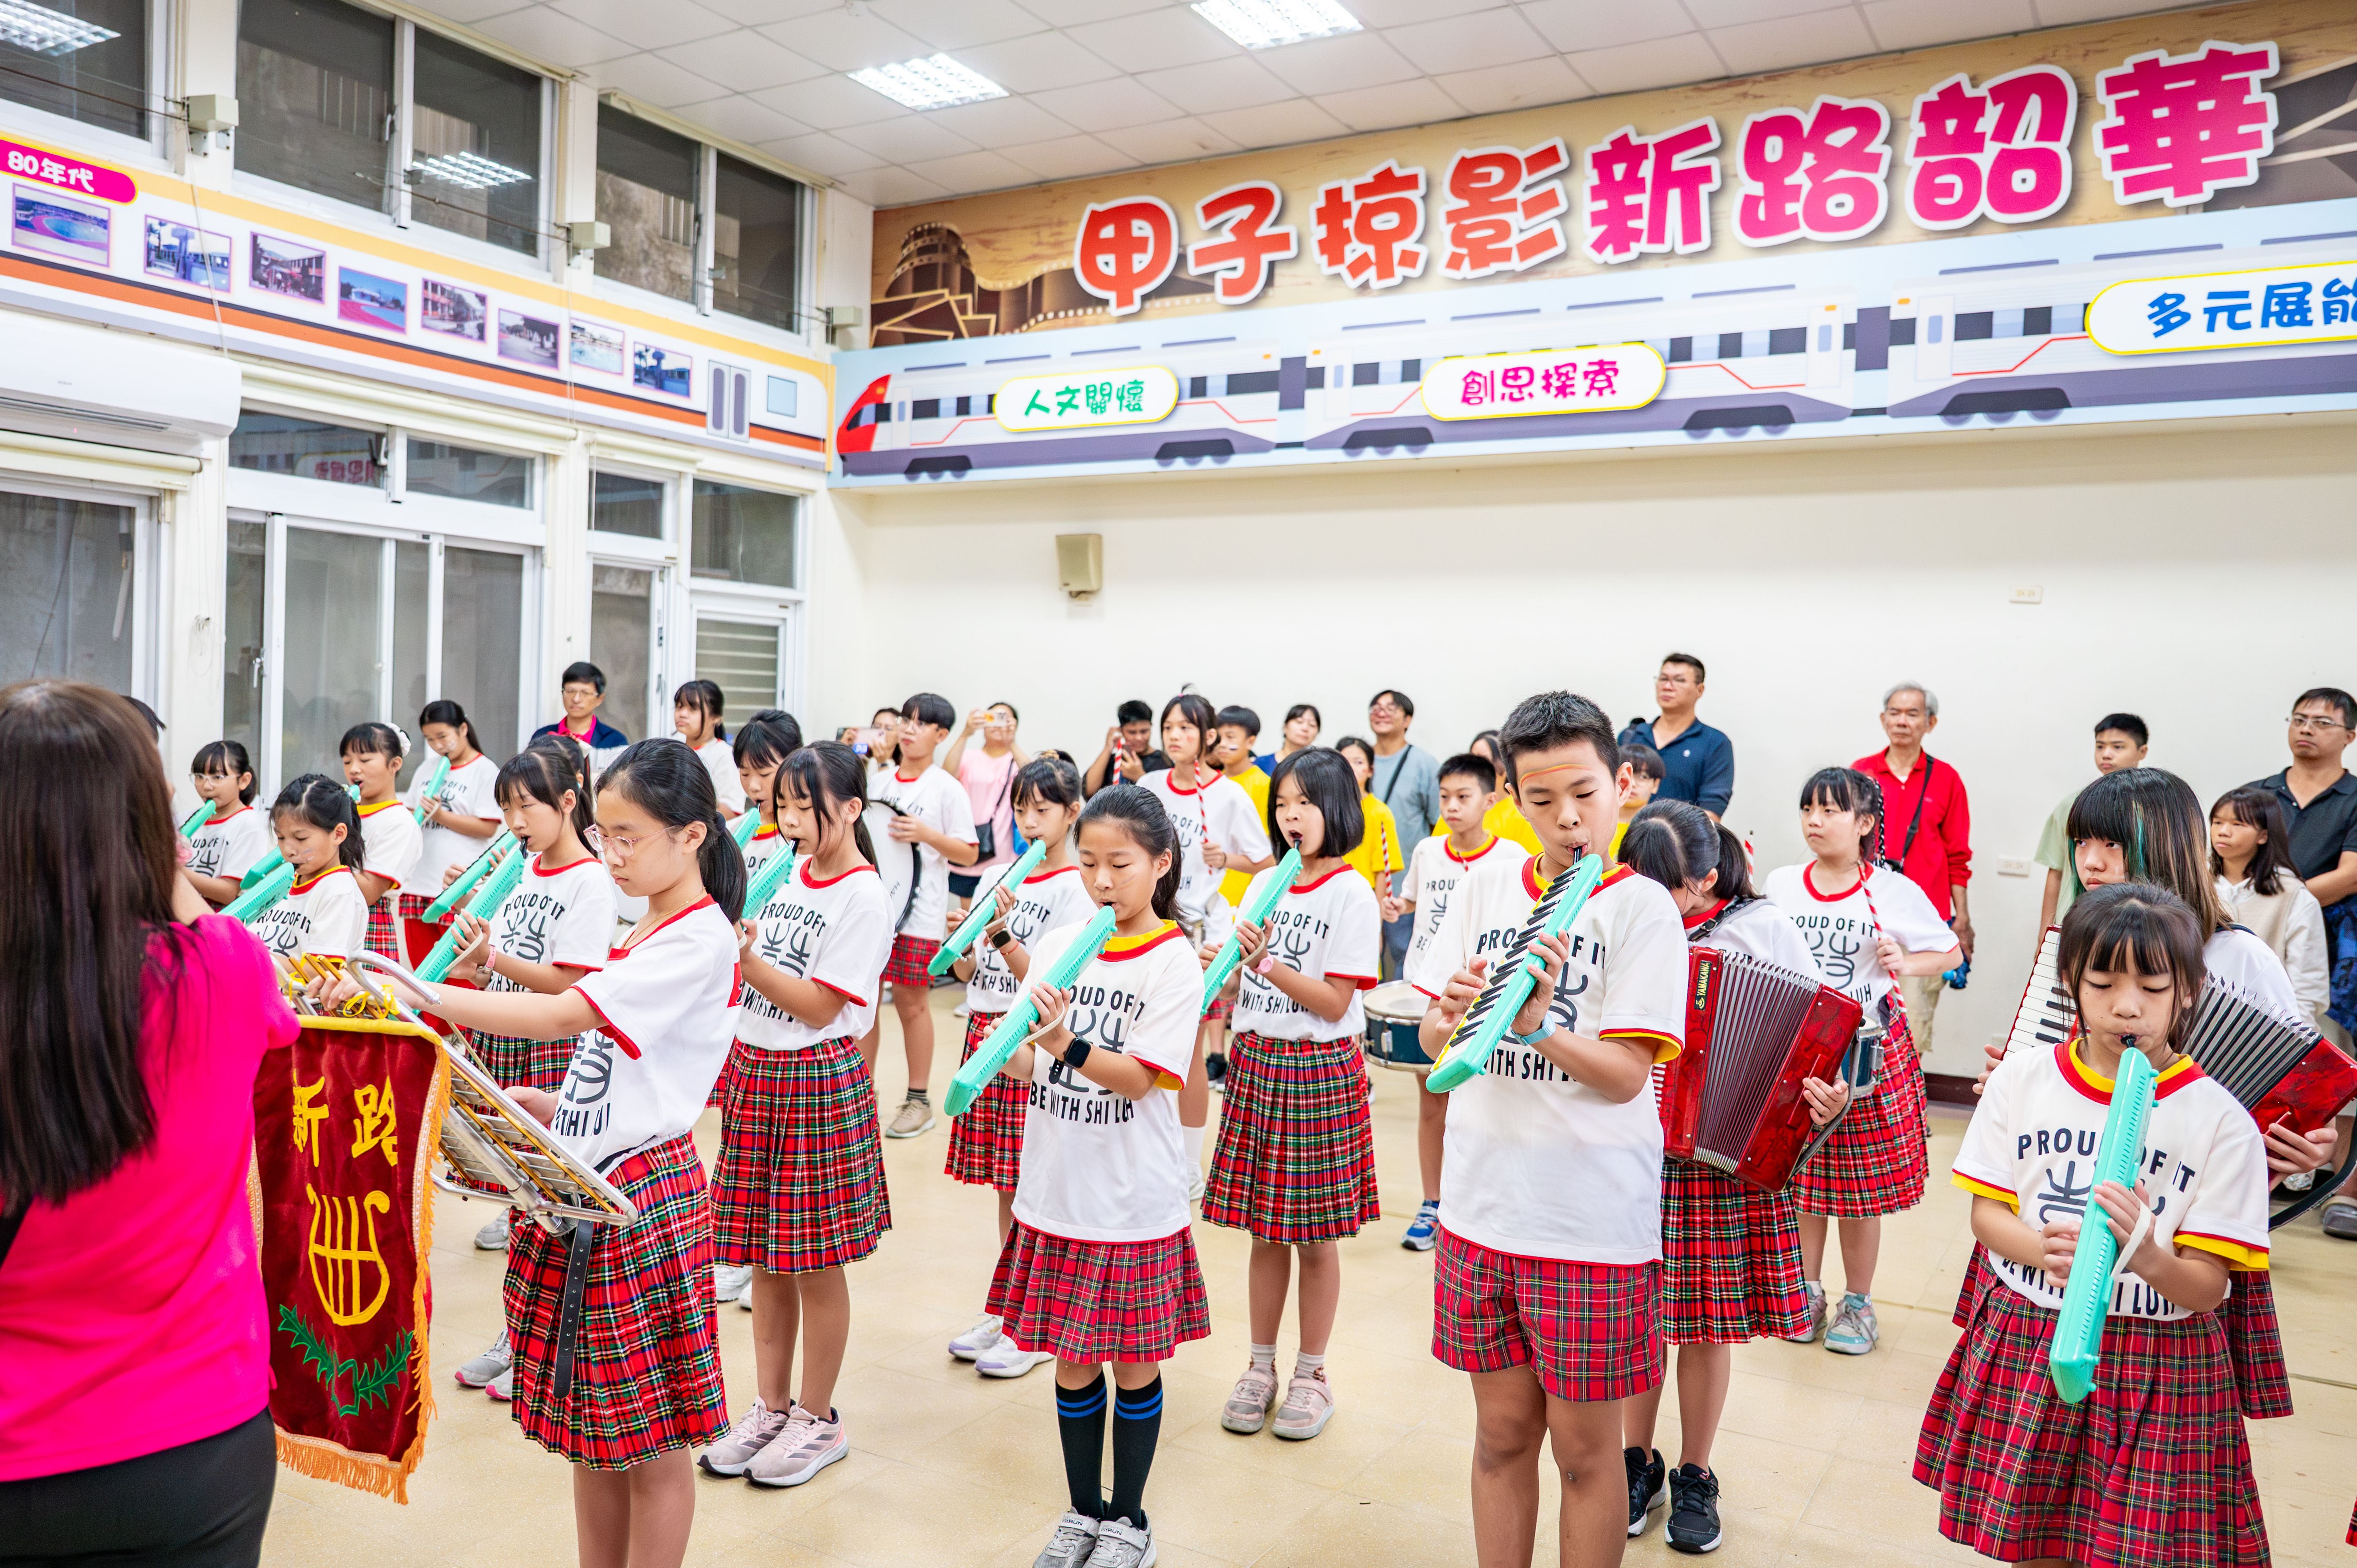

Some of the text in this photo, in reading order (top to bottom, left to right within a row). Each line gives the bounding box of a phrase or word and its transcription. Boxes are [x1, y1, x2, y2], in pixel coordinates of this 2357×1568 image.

[8, 151, 94, 193] 80年代
[1461, 359, 1619, 405] 創思探索
[1024, 379, 1144, 416] 人文關懷
[1180, 817, 1193, 829] OF
[1179, 875, 1192, 890] UH
[1426, 879, 1456, 892] PROU
[289, 911, 301, 926] OF
[300, 916, 311, 934] IT
[550, 901, 566, 921] IT
[803, 910, 823, 929] OF
[1022, 901, 1038, 915] OF
[1037, 905, 1050, 923] IT
[1293, 913, 1311, 929] OF
[1315, 920, 1329, 939] IT
[1794, 916, 1875, 938] OUD OF IT
[1476, 928, 1516, 954] PRO
[999, 976, 1017, 993] SHI
[1697, 963, 1710, 996] YAMAKAWA
[1069, 985, 1105, 1006] OUD
[1110, 990, 1135, 1013] OF
[1241, 989, 1264, 1011] WITH
[1483, 1049, 1516, 1077] ITH
[1030, 1080, 1047, 1110] BE
[1050, 1089, 1081, 1121] WITH
[1085, 1100, 1109, 1124] SHI
[2018, 1128, 2096, 1160] PROU
